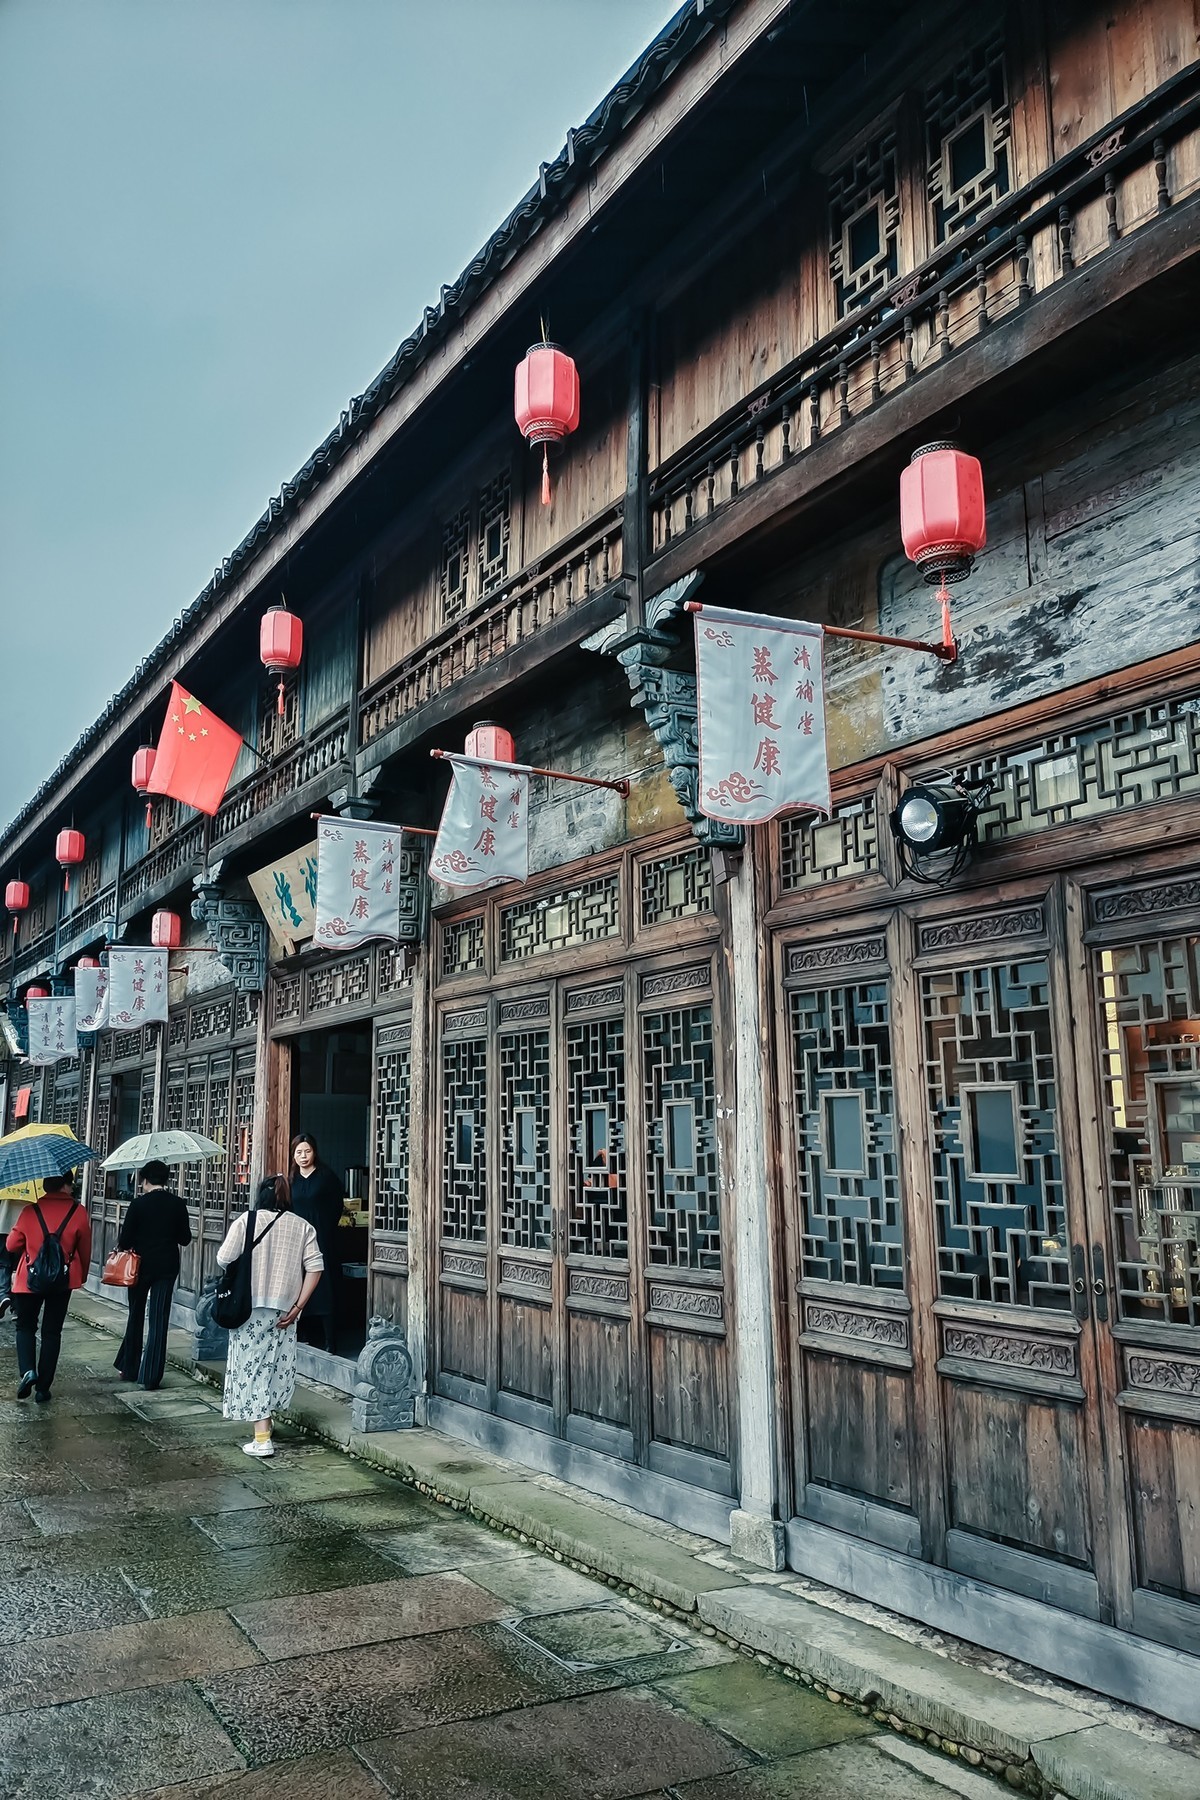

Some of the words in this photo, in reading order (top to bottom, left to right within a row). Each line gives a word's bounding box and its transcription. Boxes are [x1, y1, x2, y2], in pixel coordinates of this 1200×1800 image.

[751, 646, 782, 777] 蒸健康
[794, 645, 815, 735] 清補堂
[473, 765, 499, 856] 蒸健康
[350, 840, 371, 919] 蒸健康
[381, 839, 394, 893] 清補堂
[132, 960, 146, 1011] 蒸健康
